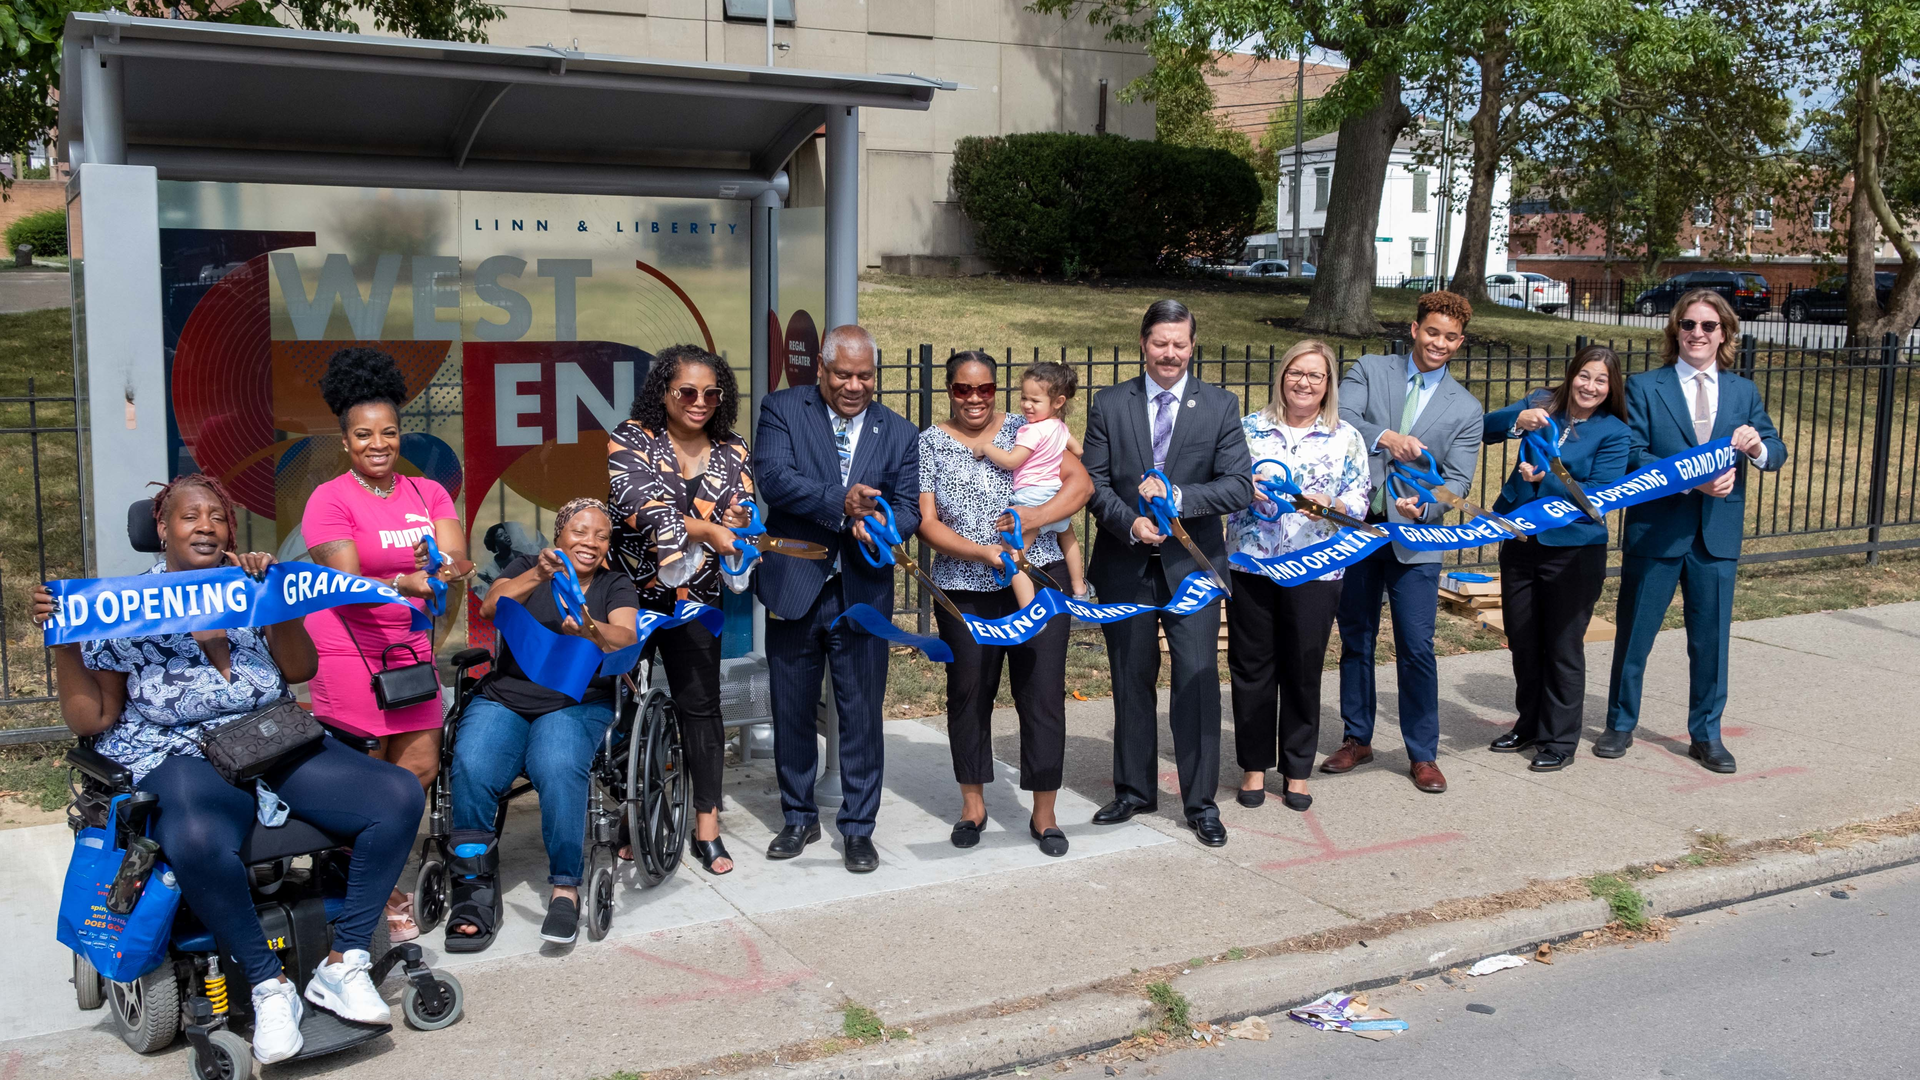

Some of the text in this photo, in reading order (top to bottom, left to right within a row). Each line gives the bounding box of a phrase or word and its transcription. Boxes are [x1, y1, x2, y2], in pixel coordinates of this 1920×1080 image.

[475, 219, 737, 235] LINN & LIBERTY
[269, 253, 592, 342] WEST
[788, 340, 805, 352] REGAL
[788, 354, 811, 367] THEATER
[494, 360, 655, 447] EN
[1596, 468, 1668, 502] OPENING
[1674, 448, 1716, 481] GRAND
[1398, 525, 1459, 543] GRAND
[96, 581, 247, 624] OPENING
[283, 571, 371, 605] GRAND
[1064, 599, 1139, 620] GRAND
[84, 919, 106, 928] DOES
